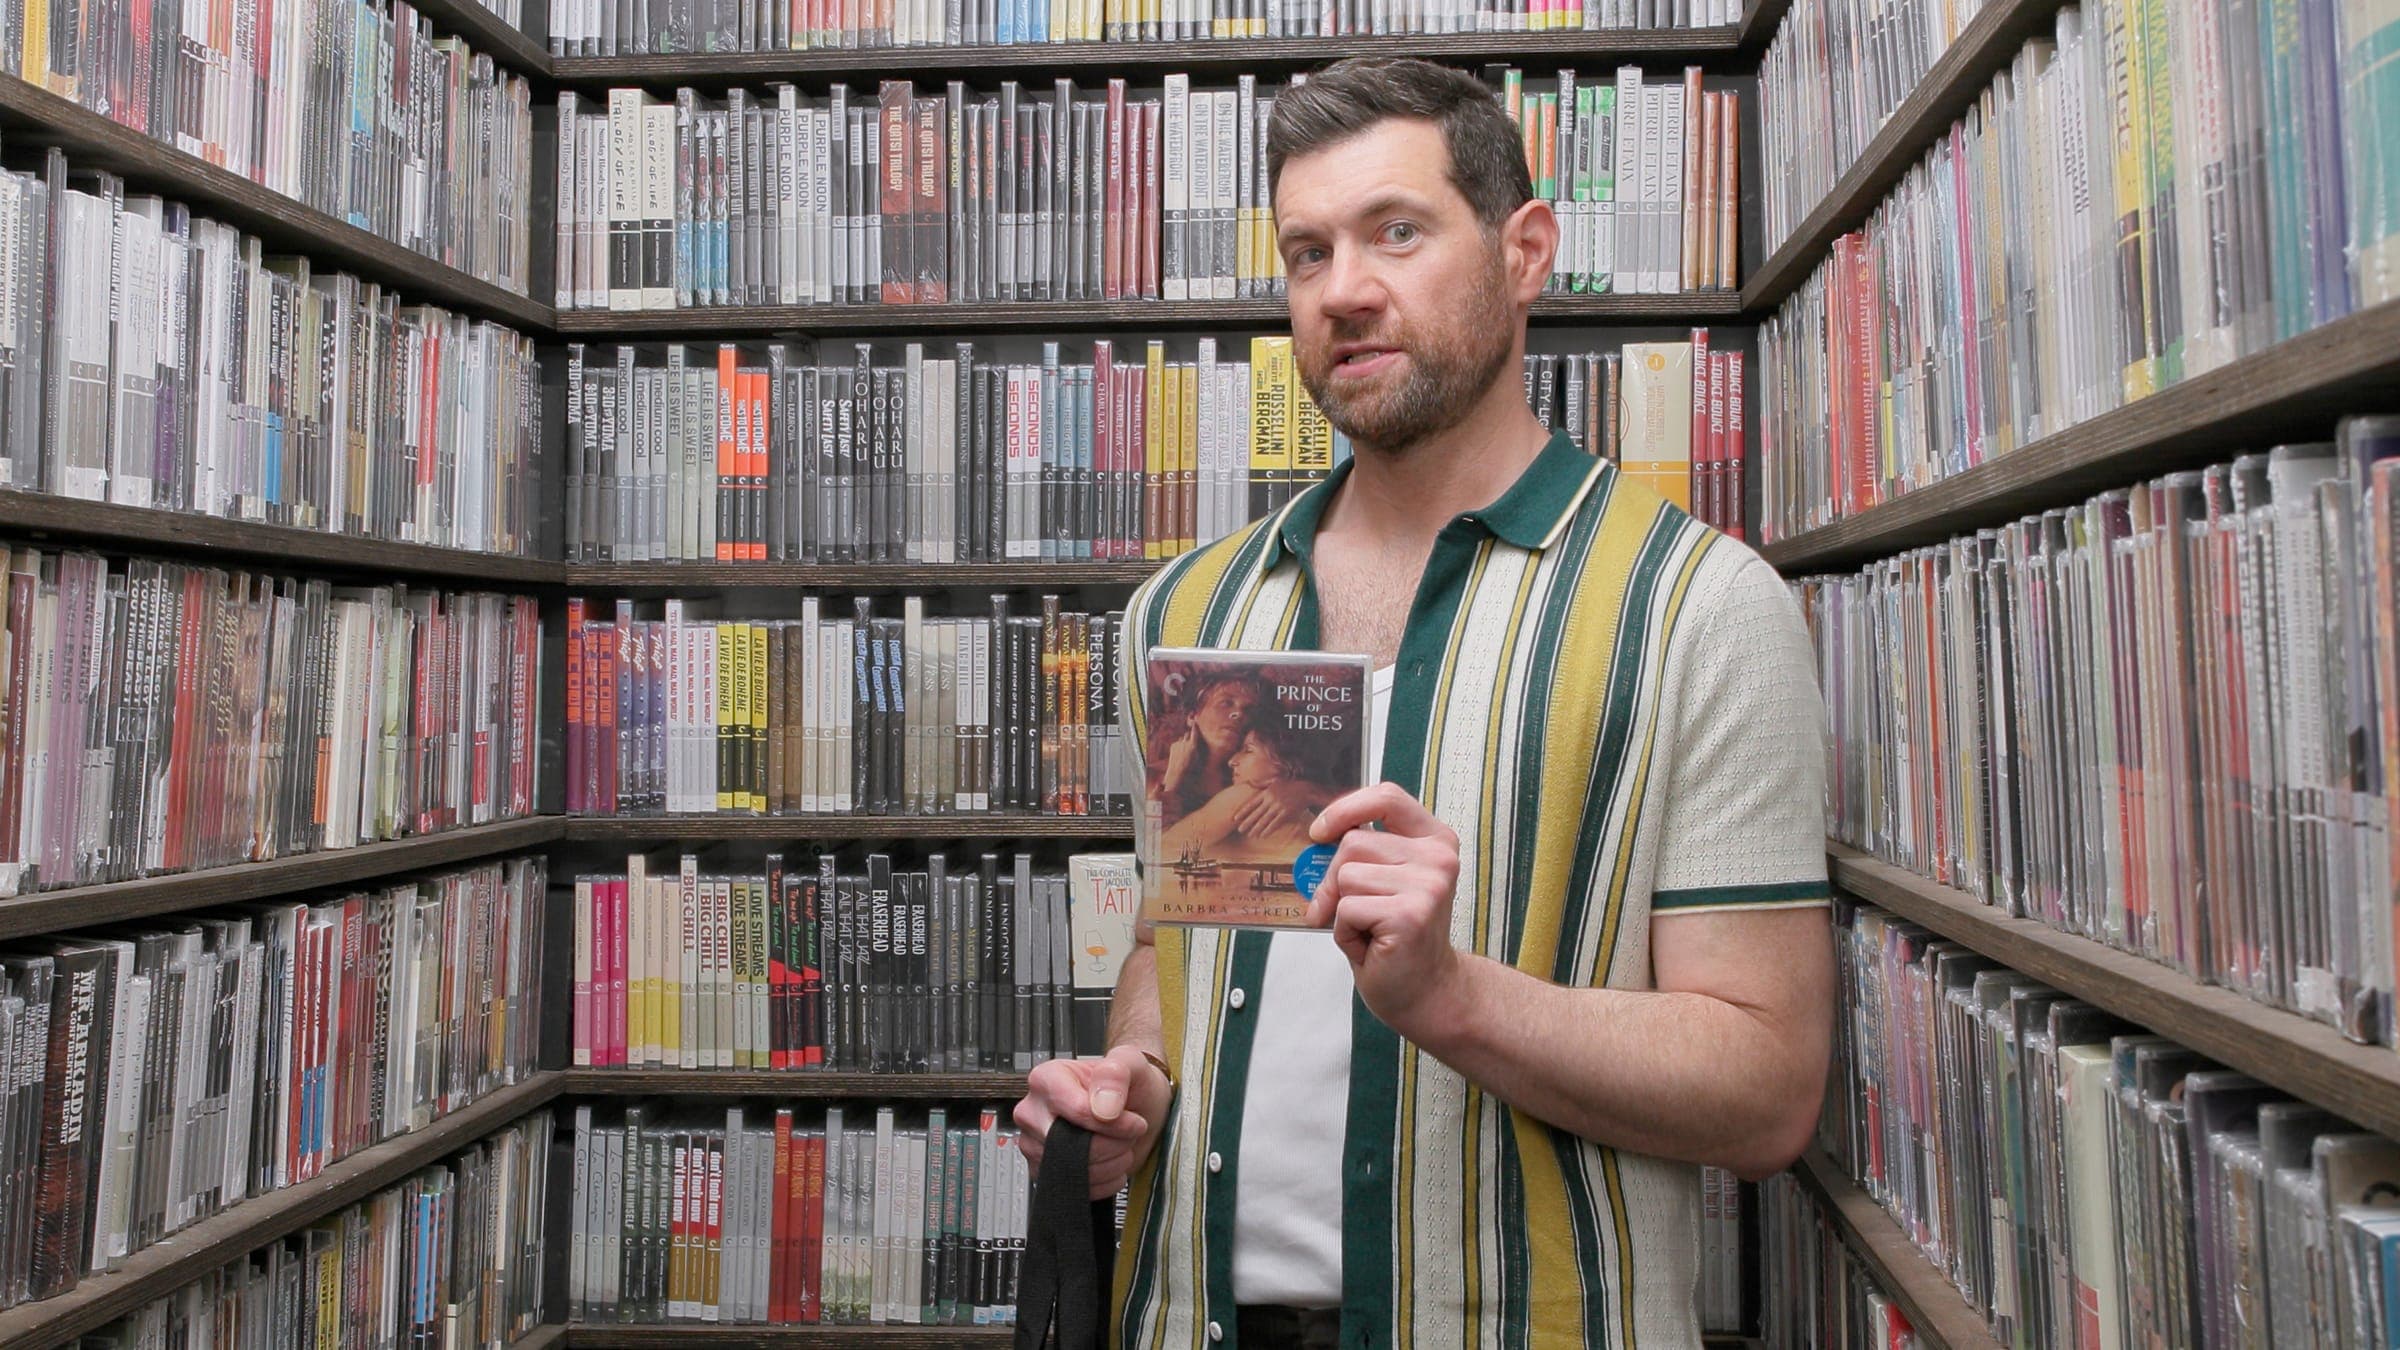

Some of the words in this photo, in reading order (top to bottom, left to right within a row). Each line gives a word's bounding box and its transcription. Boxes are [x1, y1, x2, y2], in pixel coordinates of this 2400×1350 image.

[890, 104, 901, 124] THE
[924, 111, 935, 130] THE
[1195, 105, 1208, 117] ON
[1219, 103, 1231, 115] ON
[1666, 93, 1680, 144] PIERRE
[614, 100, 623, 156] TRILOGY
[647, 116, 655, 161] TRILOGY
[798, 115, 809, 167] PURPLE
[1195, 120, 1208, 137] THE
[1219, 119, 1231, 136] THE
[816, 120, 826, 171] PURPLE
[616, 160, 624, 177] OF
[648, 166, 656, 179] OF
[890, 159, 903, 191] TRILOGY
[923, 166, 935, 198] TRILOGY
[1195, 140, 1208, 200] WATERFRONT
[1219, 139, 1231, 199] WATERFRONT
[616, 182, 624, 211] LIFE
[649, 184, 657, 208] LIFE
[798, 172, 809, 208] NOON
[816, 177, 826, 212] NOON
[703, 381, 713, 402] LIFE
[1712, 363, 1723, 397] TOUKI
[1730, 358, 1741, 393] TOUKI
[636, 381, 646, 429] medium
[654, 379, 664, 426] medium
[686, 384, 696, 407] LIFE
[1097, 383, 1105, 434] CHARULATA
[686, 412, 696, 422] IS
[703, 409, 713, 420] IS
[1009, 381, 1019, 458] SECONDS
[1028, 380, 1038, 457] SECONDS
[1116, 394, 1124, 445] CHARULATA
[1256, 392, 1270, 455] BERGMAN
[1271, 384, 1285, 455] ROSSELLINI
[1712, 400, 1723, 434] BOUKI
[1730, 397, 1741, 431] BOUKI
[636, 432, 646, 458] cool
[654, 429, 664, 455] cool
[686, 428, 696, 466] SWEET
[702, 425, 713, 463] SWEET
[873, 397, 885, 469] OHARU
[891, 396, 903, 468] OHARU
[1298, 402, 1312, 464] BERGMAN
[129, 576, 139, 633] YOUTH
[138, 579, 149, 633] YOUTH
[632, 636, 647, 671] Thief
[651, 633, 664, 669] Thief
[720, 635, 728, 645] LA
[720, 648, 728, 661] VIE
[737, 634, 745, 645] LA
[737, 648, 745, 660] VIE
[124, 650, 135, 706] BEAST
[134, 650, 144, 706] BEAST
[720, 664, 728, 674] DE
[737, 663, 745, 673] DE
[925, 664, 938, 691] Tess
[1090, 634, 1103, 710] PERSONA
[1304, 675, 1325, 684] THE
[720, 677, 730, 712] BOHÈME
[737, 676, 747, 711] BOHÈME
[1276, 685, 1352, 702] PRINCE
[1306, 703, 1321, 713] OF
[1283, 714, 1343, 731] TIDES
[684, 876, 694, 903] BIG
[734, 888, 745, 917] LOVE
[751, 890, 762, 918] LOVE
[839, 891, 851, 910] ALL
[1090, 878, 1133, 915] TATI
[701, 895, 711, 922] BIG
[717, 895, 730, 923] BIG
[873, 890, 888, 951] ERASERHEAD
[1163, 903, 1228, 915] BARBRA
[684, 907, 694, 953] CHILL
[840, 912, 852, 938] THAT
[894, 905, 906, 954] ERASERHEAD
[912, 905, 925, 954] ERASERHEAD
[701, 926, 712, 973] CHILL
[717, 926, 730, 973] CHILL
[735, 920, 746, 975] STREAMS
[752, 922, 764, 976] STREAMS
[840, 940, 854, 964] JAZZ
[77, 971, 92, 1021] MR.
[64, 1011, 76, 1096] CONFIDENTIAL
[68, 1023, 88, 1144] ARKADIN
[60, 1100, 70, 1145] REPORT
[628, 1126, 637, 1150] EVERY
[932, 1125, 942, 1146] RIDE
[628, 1154, 636, 1171] MAN
[675, 1148, 686, 1173] don't
[692, 1148, 704, 1173] don't
[931, 1152, 941, 1168] THE
[627, 1174, 635, 1190] FOR
[674, 1175, 684, 1197] look
[692, 1175, 703, 1197] look
[930, 1174, 940, 1195] PINK
[625, 1193, 634, 1229] HIMSELF
[642, 1199, 650, 1229] HIMSELF
[673, 1199, 683, 1222] now
[691, 1200, 700, 1222] now
[929, 1202, 939, 1231] HORSE
